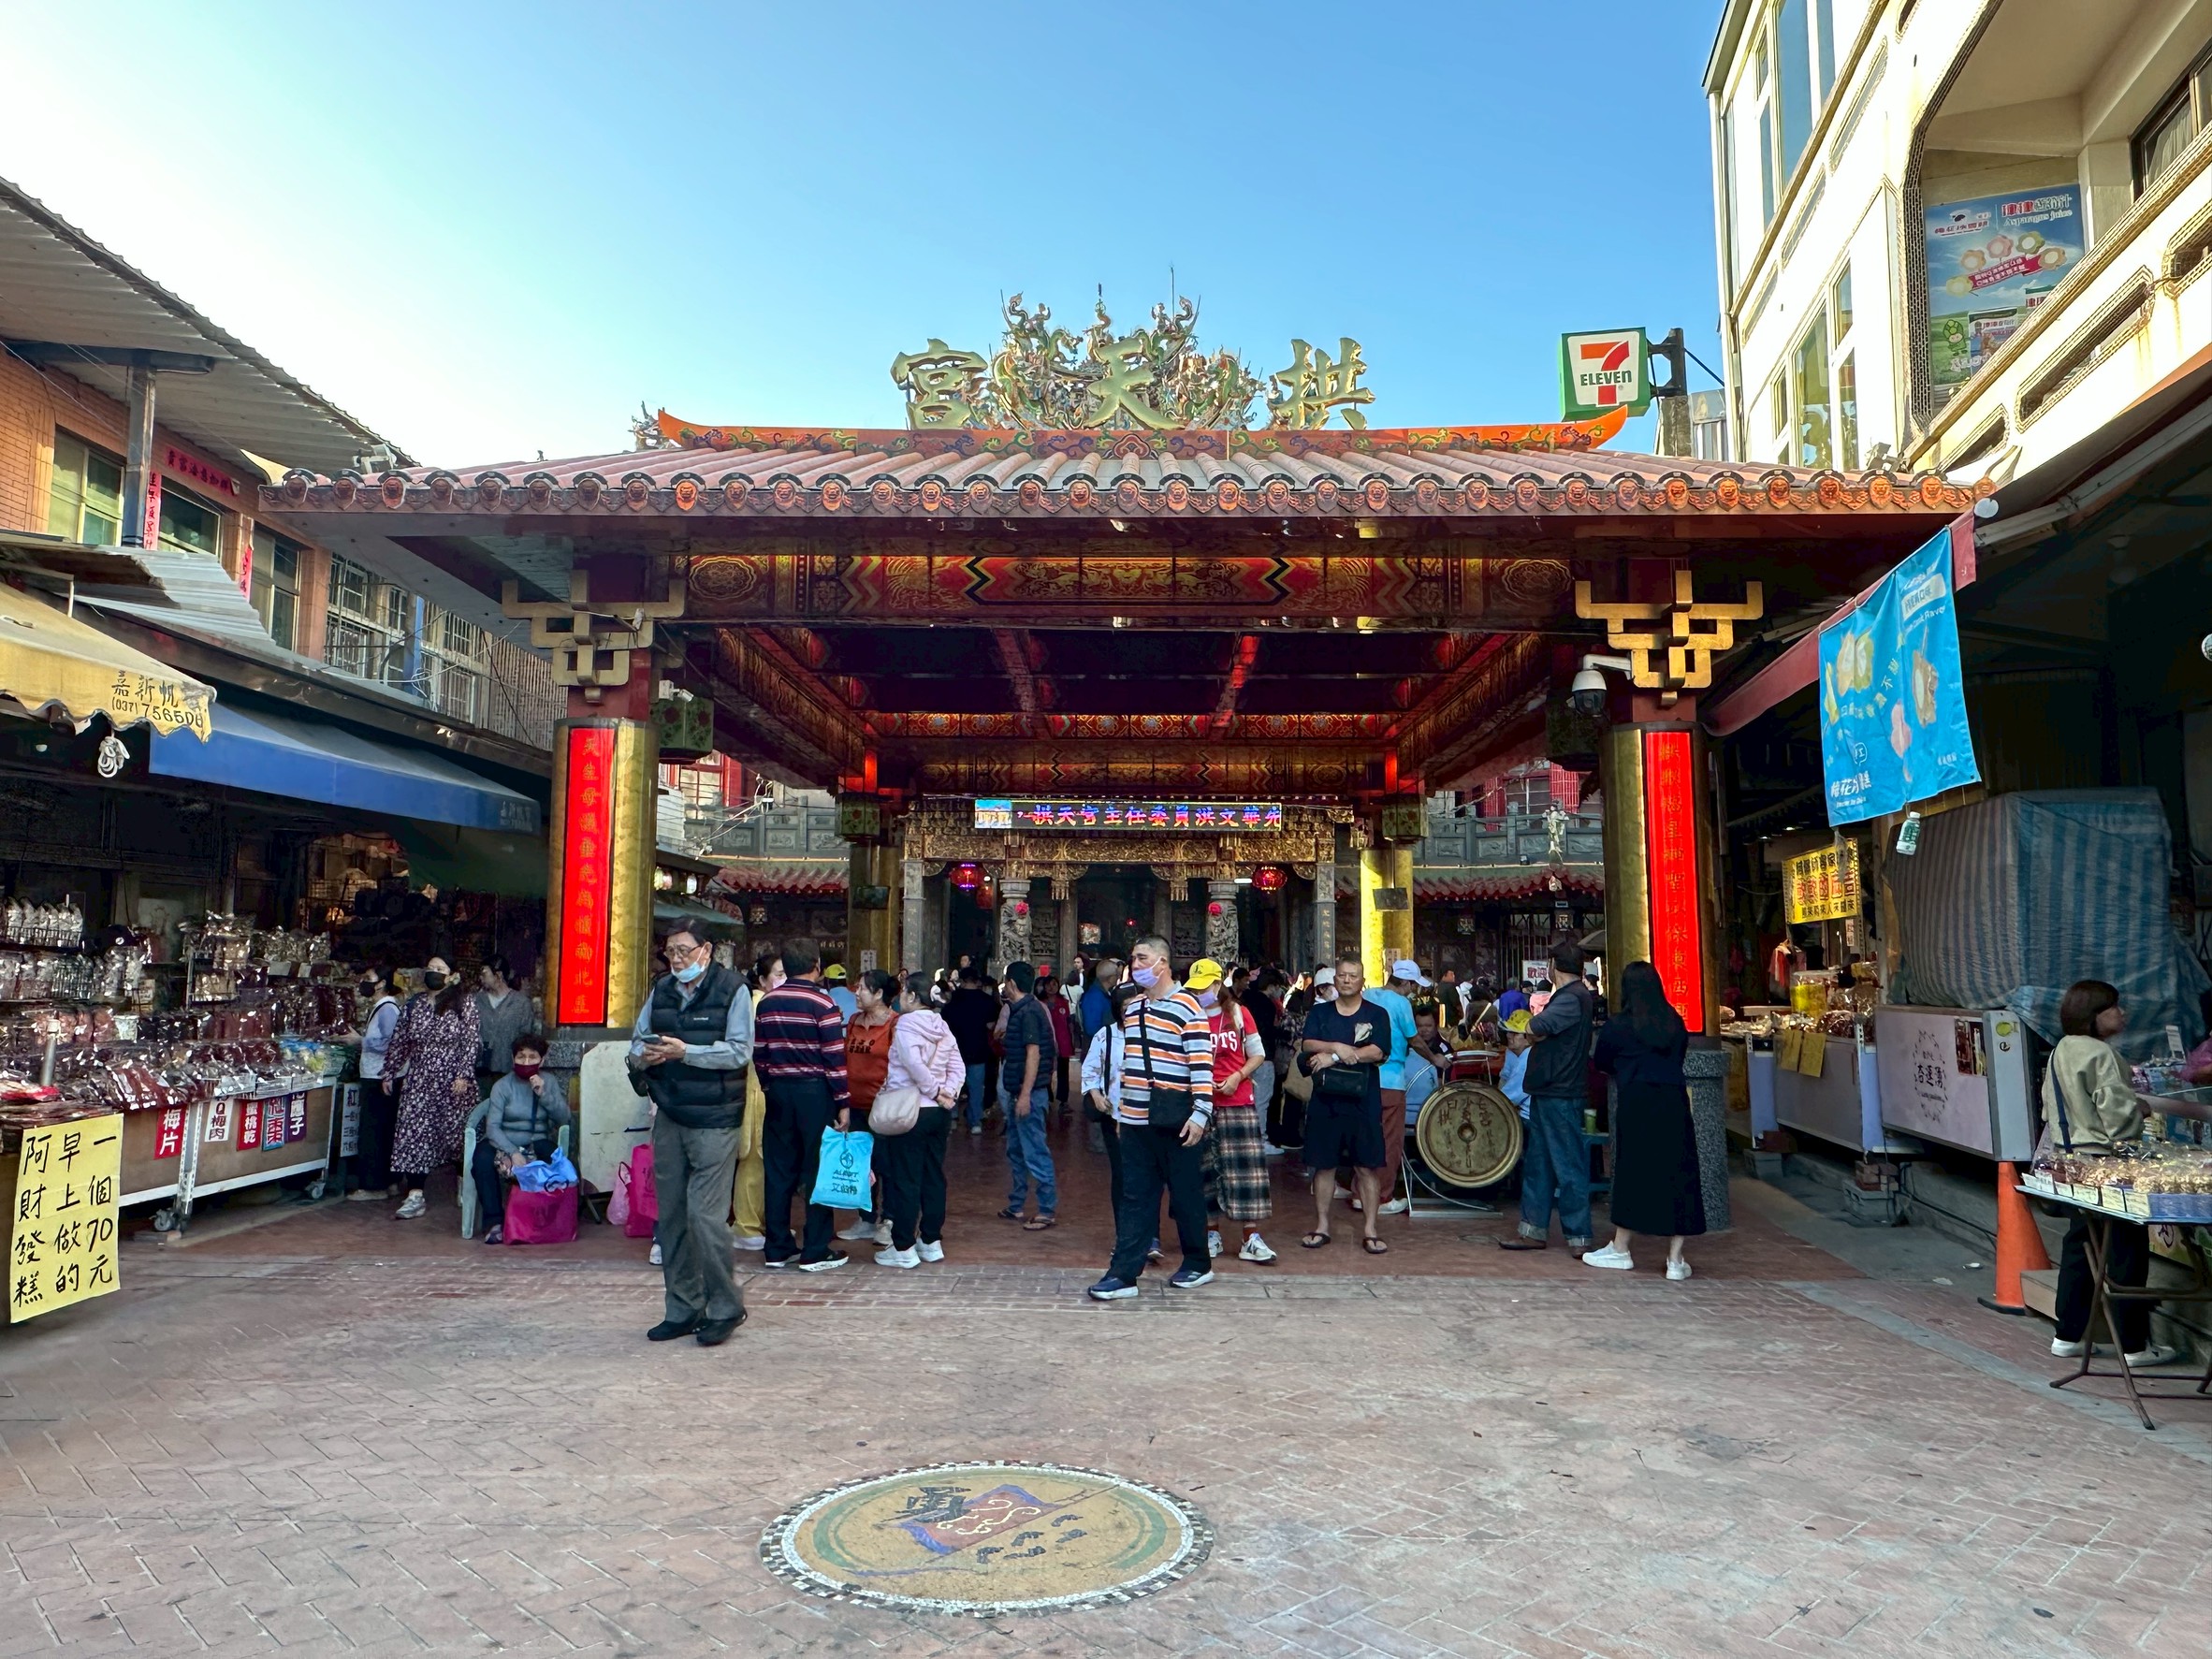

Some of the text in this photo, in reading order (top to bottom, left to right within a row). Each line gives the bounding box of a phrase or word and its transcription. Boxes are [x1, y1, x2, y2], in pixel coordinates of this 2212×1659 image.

[1579, 341, 1630, 405] 7
[13, 1133, 52, 1308] 阿財發糕
[54, 1130, 81, 1294] 早上做的
